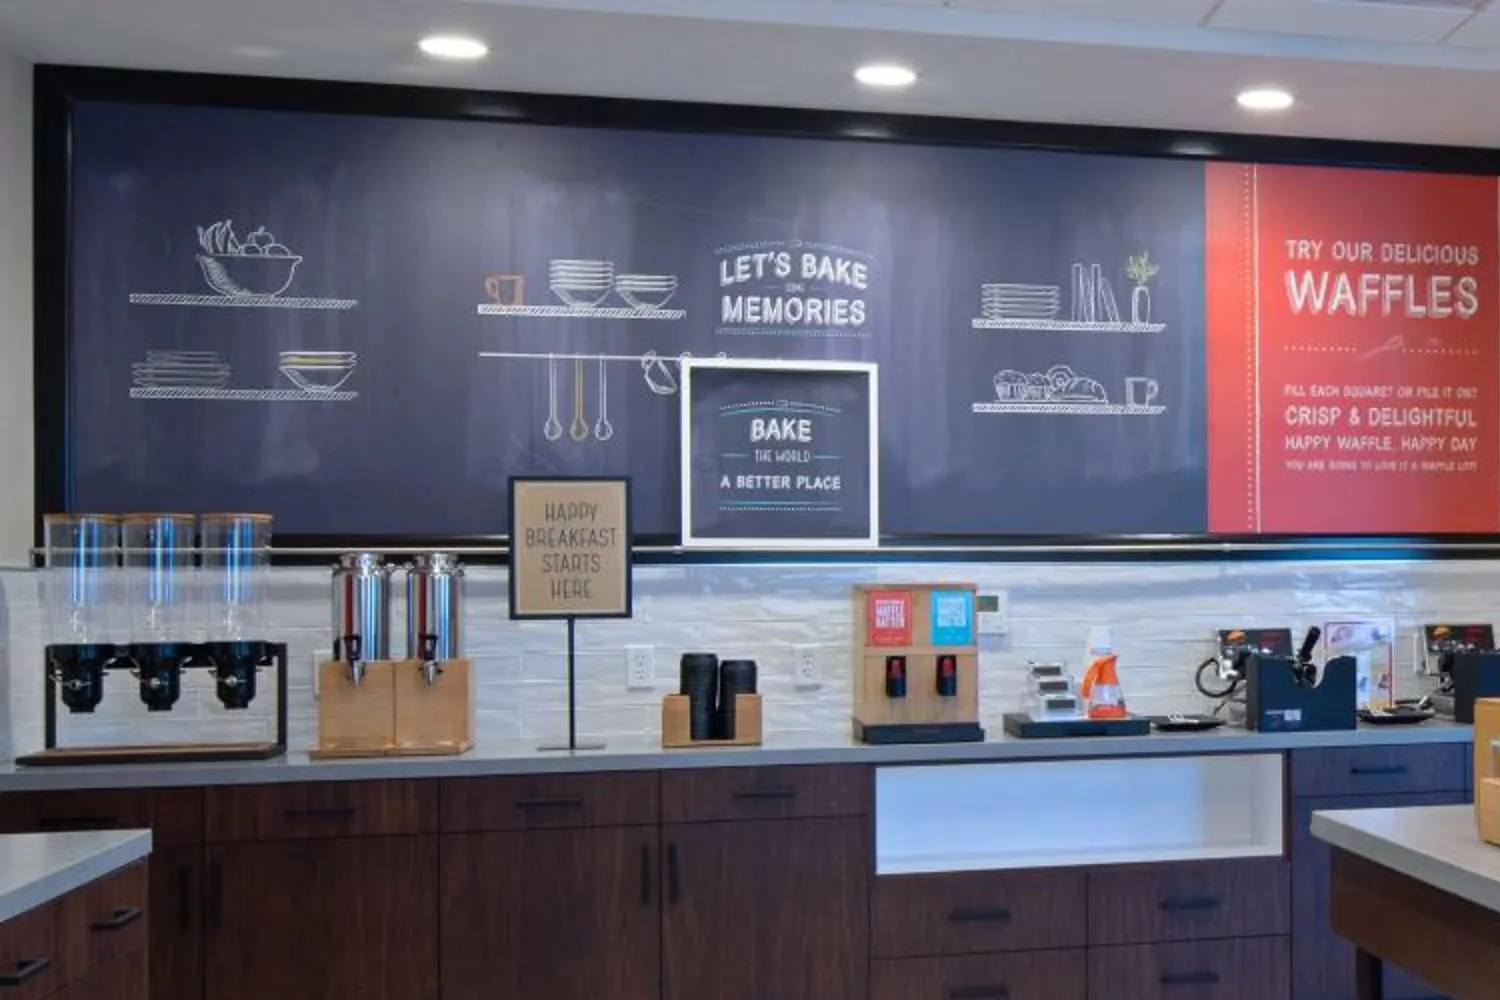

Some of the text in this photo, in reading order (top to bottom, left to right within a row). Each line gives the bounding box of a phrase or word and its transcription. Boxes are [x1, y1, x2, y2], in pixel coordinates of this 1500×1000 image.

[1286, 239, 1479, 264] TRY OUR DELICIOUS
[719, 251, 868, 290] LET'S BAKE
[1284, 269, 1479, 319] WAFFLES
[721, 295, 866, 325] MEMORIES
[1311, 385, 1340, 397] EACH
[1285, 405, 1477, 428] CRISP & DELIGHTFUL
[750, 417, 812, 442] BAKE
[1285, 435, 1330, 450] HAPPY
[1401, 435, 1445, 451] HAPPY
[1450, 436, 1477, 451] DAY
[755, 449, 811, 462] THE WORLD
[720, 475, 841, 490] A BETTER PLACE
[545, 501, 598, 522] HAPPY
[525, 527, 616, 548] BREAKFAST
[542, 554, 601, 574] STARTS
[551, 578, 593, 600] HERE
